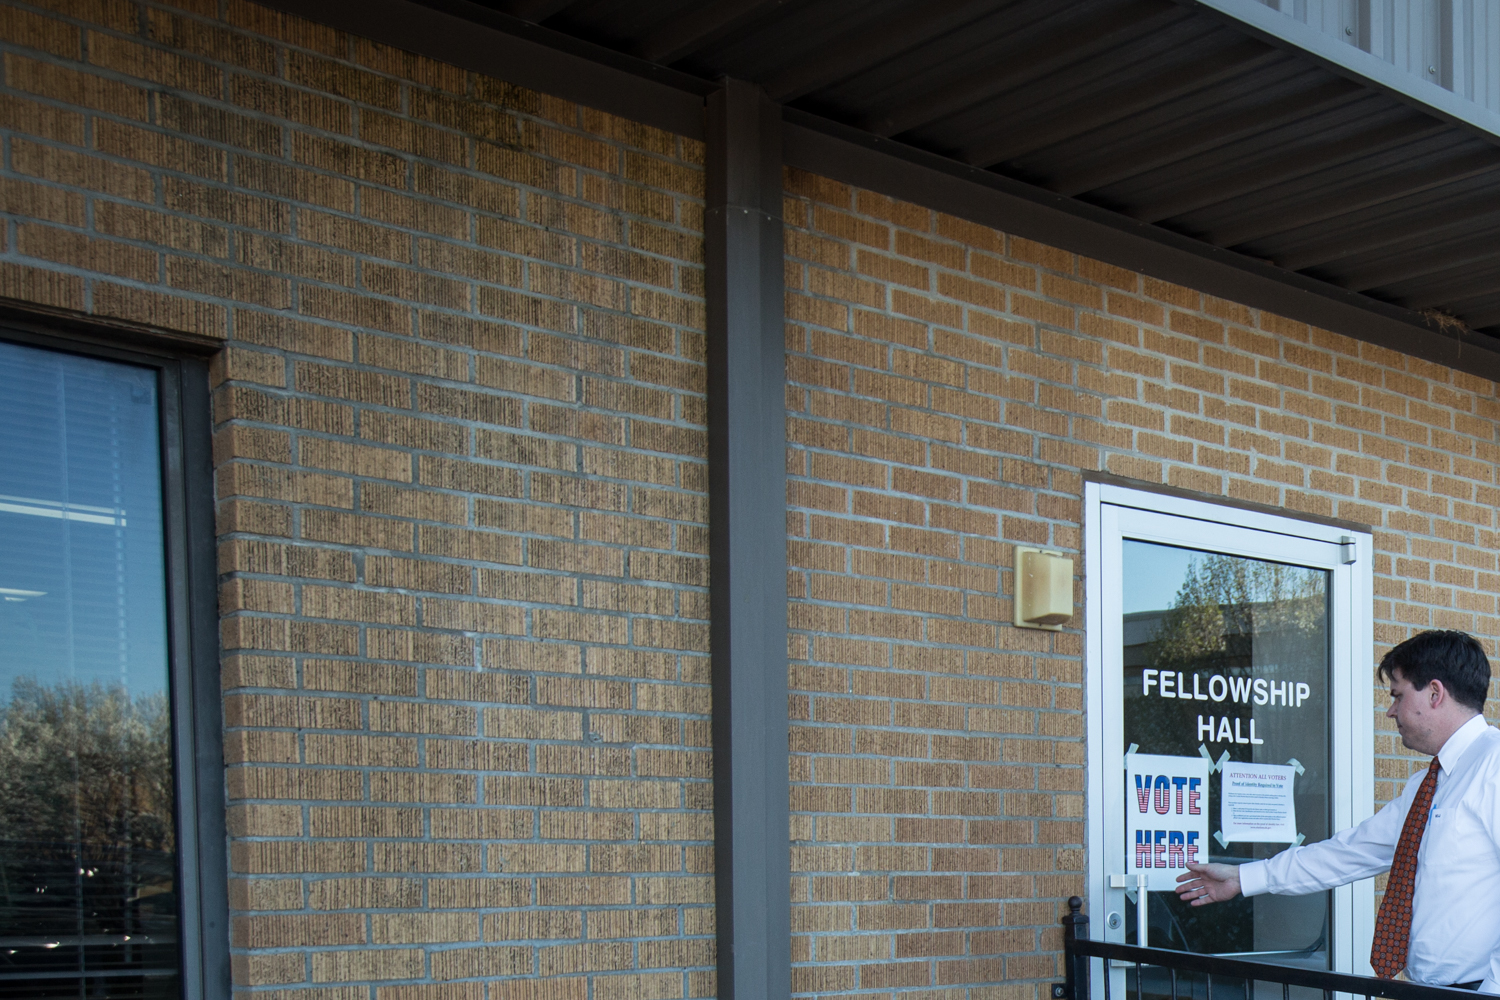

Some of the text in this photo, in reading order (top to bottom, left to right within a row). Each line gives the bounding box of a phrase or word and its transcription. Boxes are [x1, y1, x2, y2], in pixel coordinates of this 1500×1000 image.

[1142, 669, 1310, 707] FELLOWSHIP
[1197, 714, 1264, 744] HALL
[1134, 774, 1202, 815] VOTE
[1135, 829, 1200, 868] HERE
